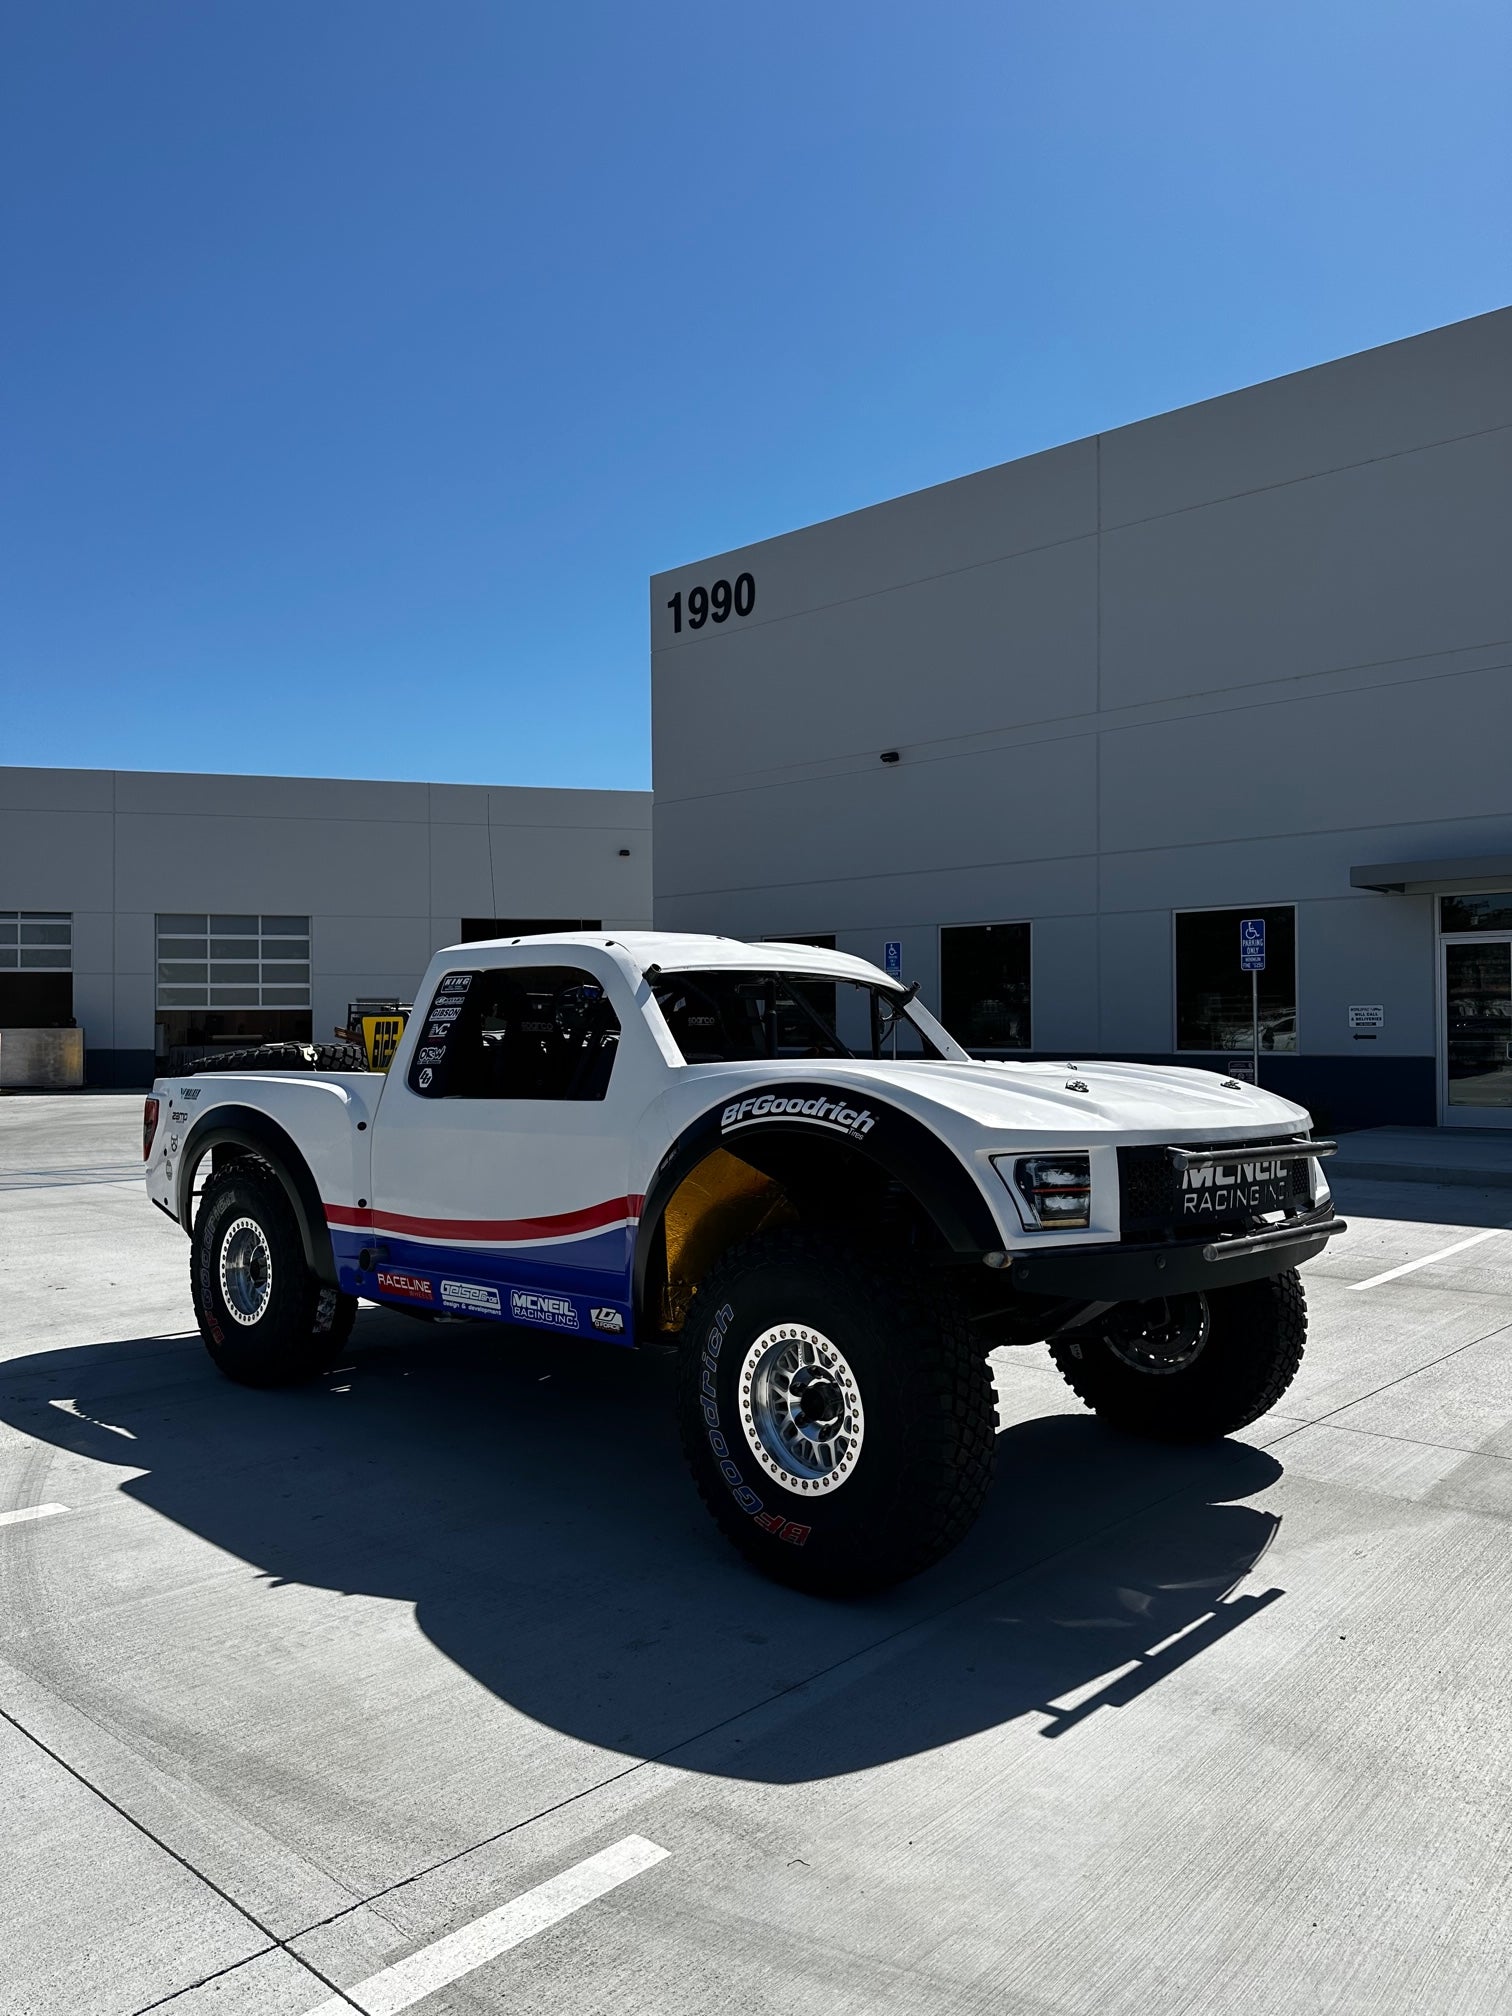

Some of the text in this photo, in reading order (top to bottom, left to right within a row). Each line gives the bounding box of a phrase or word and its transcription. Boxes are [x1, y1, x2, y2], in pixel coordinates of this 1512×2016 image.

[667, 572, 756, 634] 1990
[1242, 939, 1263, 947] PARKING
[1246, 947, 1259, 955] ONLY
[445, 978, 470, 986] KING
[432, 1009, 460, 1017] GIBSON
[172, 1111, 188, 1121] zamp
[721, 1094, 875, 1134] BFGoodrich
[848, 1127, 864, 1141] Tires
[1183, 1186, 1260, 1214] RACING
[202, 1190, 236, 1344] BFGoodrich
[377, 1273, 431, 1293] RACELINE
[409, 1290, 433, 1300] WHEELS
[443, 1300, 460, 1309] design
[468, 1304, 502, 1316] development
[513, 1293, 575, 1317] MCNEIL
[514, 1307, 577, 1326] RACING INC.
[699, 1303, 811, 1546] BFGoodrich
